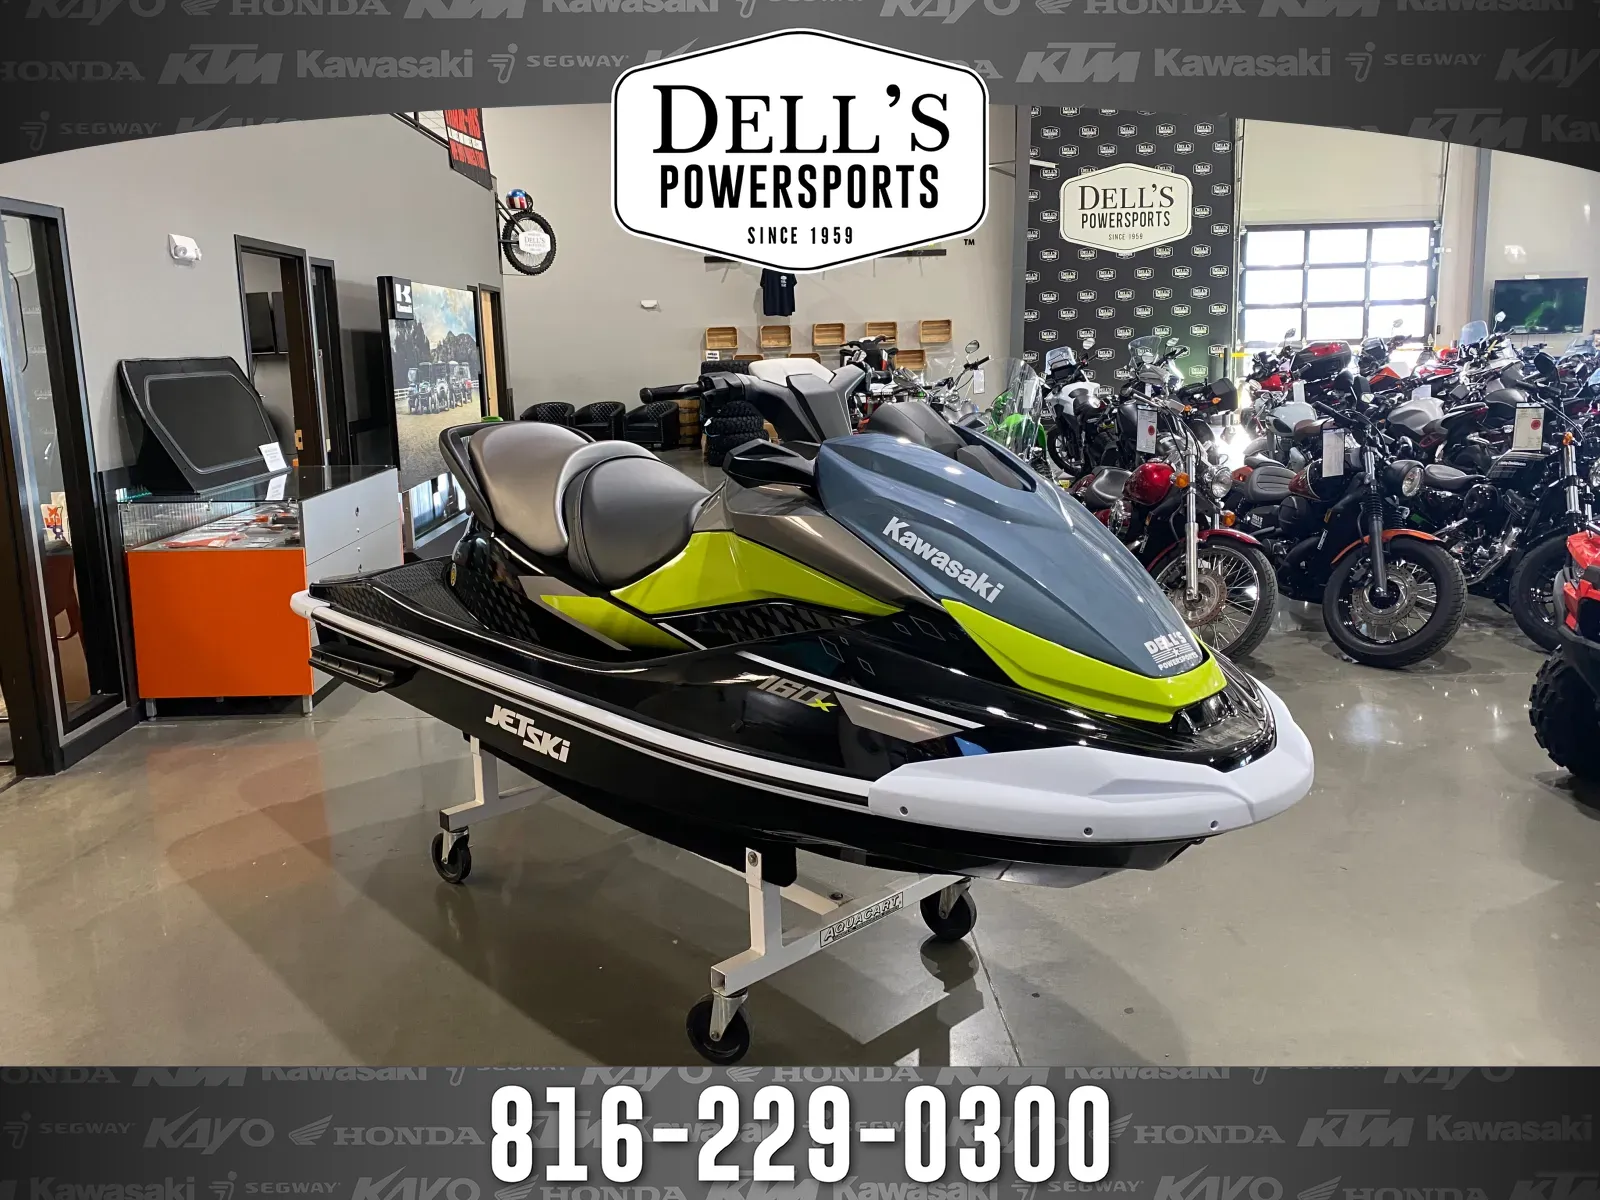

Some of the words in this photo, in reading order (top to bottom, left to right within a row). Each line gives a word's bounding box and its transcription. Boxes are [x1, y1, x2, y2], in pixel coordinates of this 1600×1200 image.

[1078, 184, 1174, 210] DELL'S
[1081, 211, 1170, 229] POWERSPORTS
[882, 516, 1005, 604] Kawasaki
[1143, 631, 1187, 655] DELL'S
[1158, 651, 1199, 671] POWERSPORTS
[824, 895, 900, 942] AQUACART
